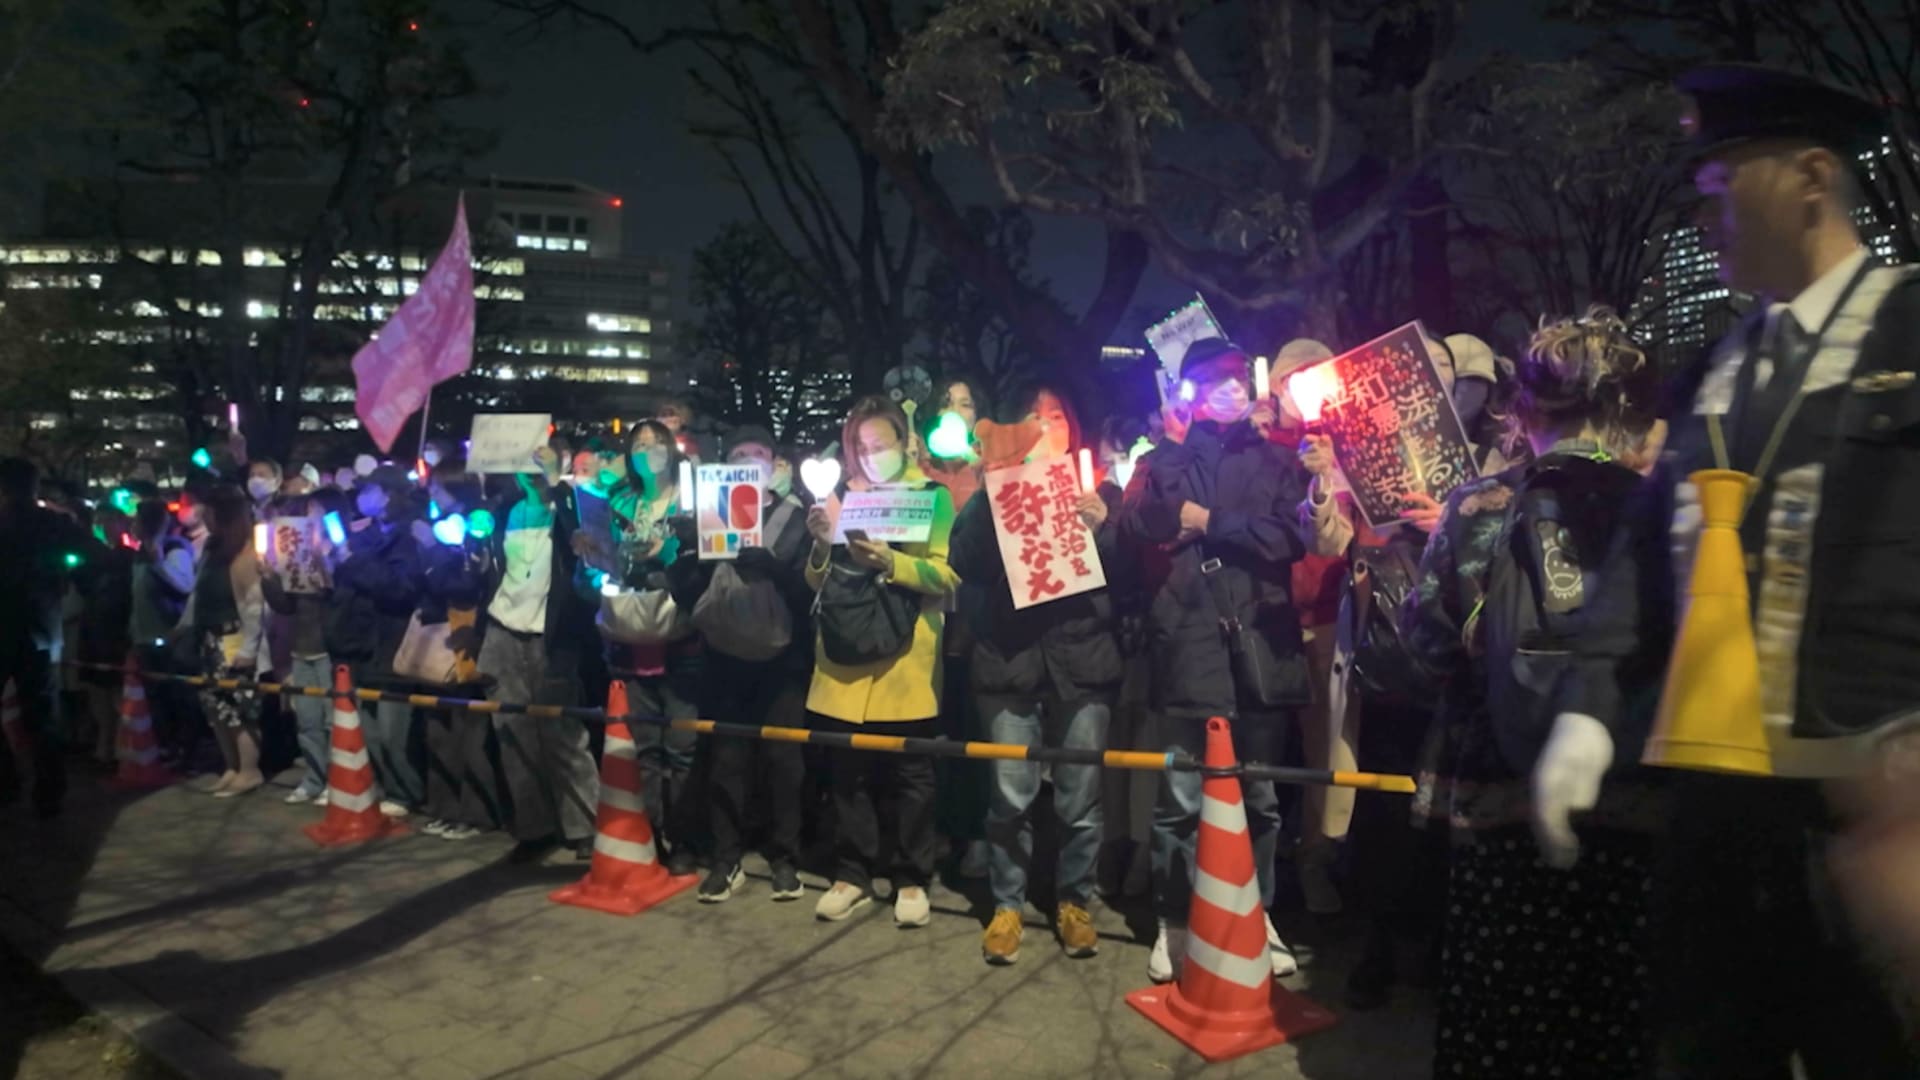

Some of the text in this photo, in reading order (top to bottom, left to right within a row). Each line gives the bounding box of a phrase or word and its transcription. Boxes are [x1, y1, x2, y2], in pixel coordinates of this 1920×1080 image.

[1323, 366, 1390, 424] 平和
[1368, 387, 1434, 436] 憲法
[700, 468, 759, 482] TAKAICHI
[701, 483, 759, 531] NO
